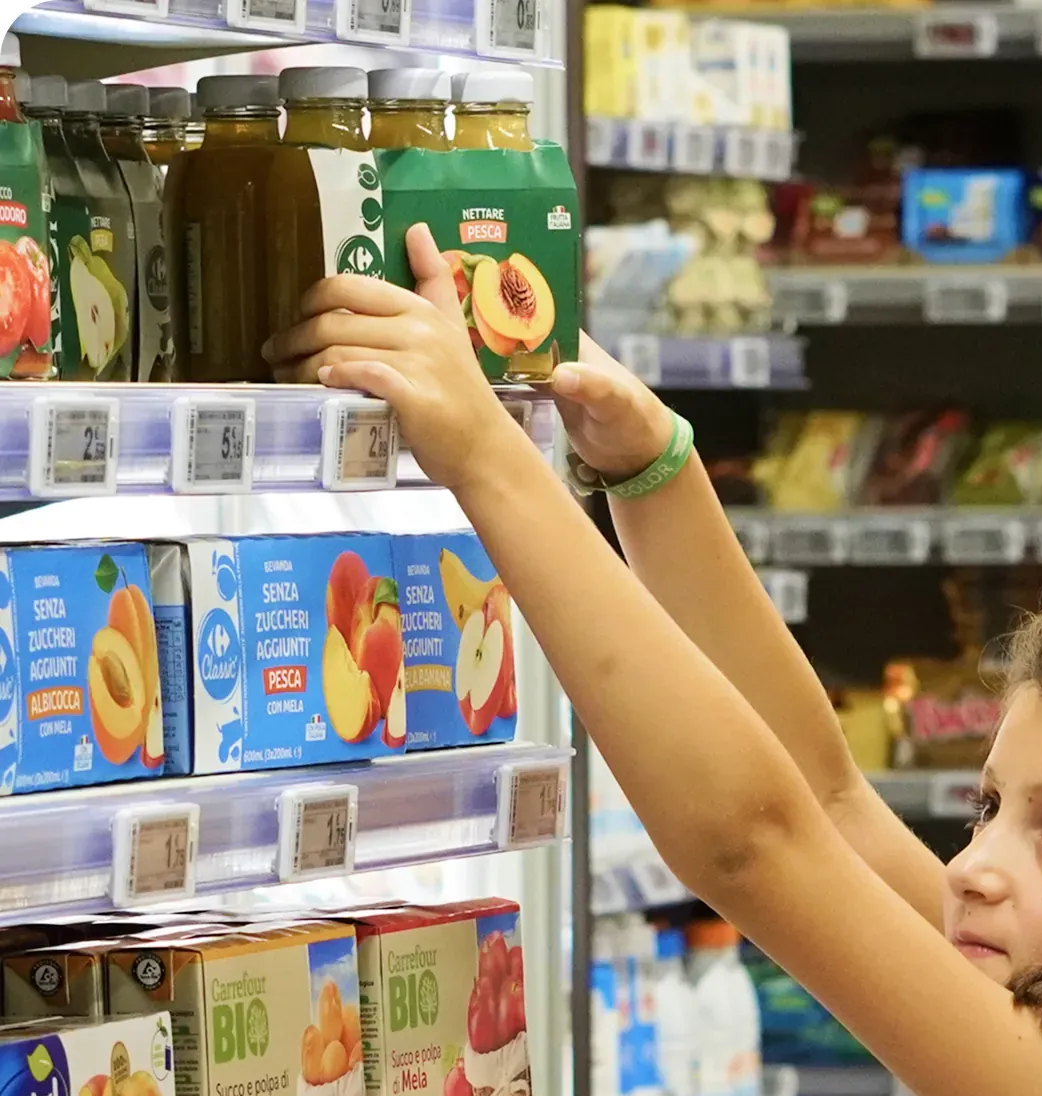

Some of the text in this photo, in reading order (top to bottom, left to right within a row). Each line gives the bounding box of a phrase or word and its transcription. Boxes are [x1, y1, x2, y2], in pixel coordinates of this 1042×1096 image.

[462, 208, 504, 220] NETTARE
[467, 224, 502, 239] PESCA
[263, 559, 293, 573] BEVANDA
[34, 575, 60, 589] BEVANDA
[262, 582, 299, 604] SENZA
[405, 585, 435, 605] SENZA
[33, 598, 66, 620] SENZA
[255, 609, 309, 632] ZUCCHERI
[400, 611, 443, 633] ZUCCHERI
[28, 627, 76, 652] ZUCCHERI
[256, 637, 310, 660] AGGIUNTI
[30, 657, 77, 681] AGGIUNTI
[268, 669, 302, 690] PESCA
[404, 672, 451, 689] ELA BANANA
[31, 690, 80, 715] ALBICOCCA
[266, 699, 304, 715] CON MELA
[39, 721, 72, 738] CON MELA
[388, 944, 437, 974] Carrefour
[211, 973, 266, 1002] Carrefour
[388, 969, 438, 1032] BIO
[212, 997, 270, 1064] BIO
[392, 1043, 441, 1068] Succo e polpa
[247, 1080, 254, 1091] e
[281, 1070, 290, 1089] di
[392, 1068, 427, 1095] di Mela
